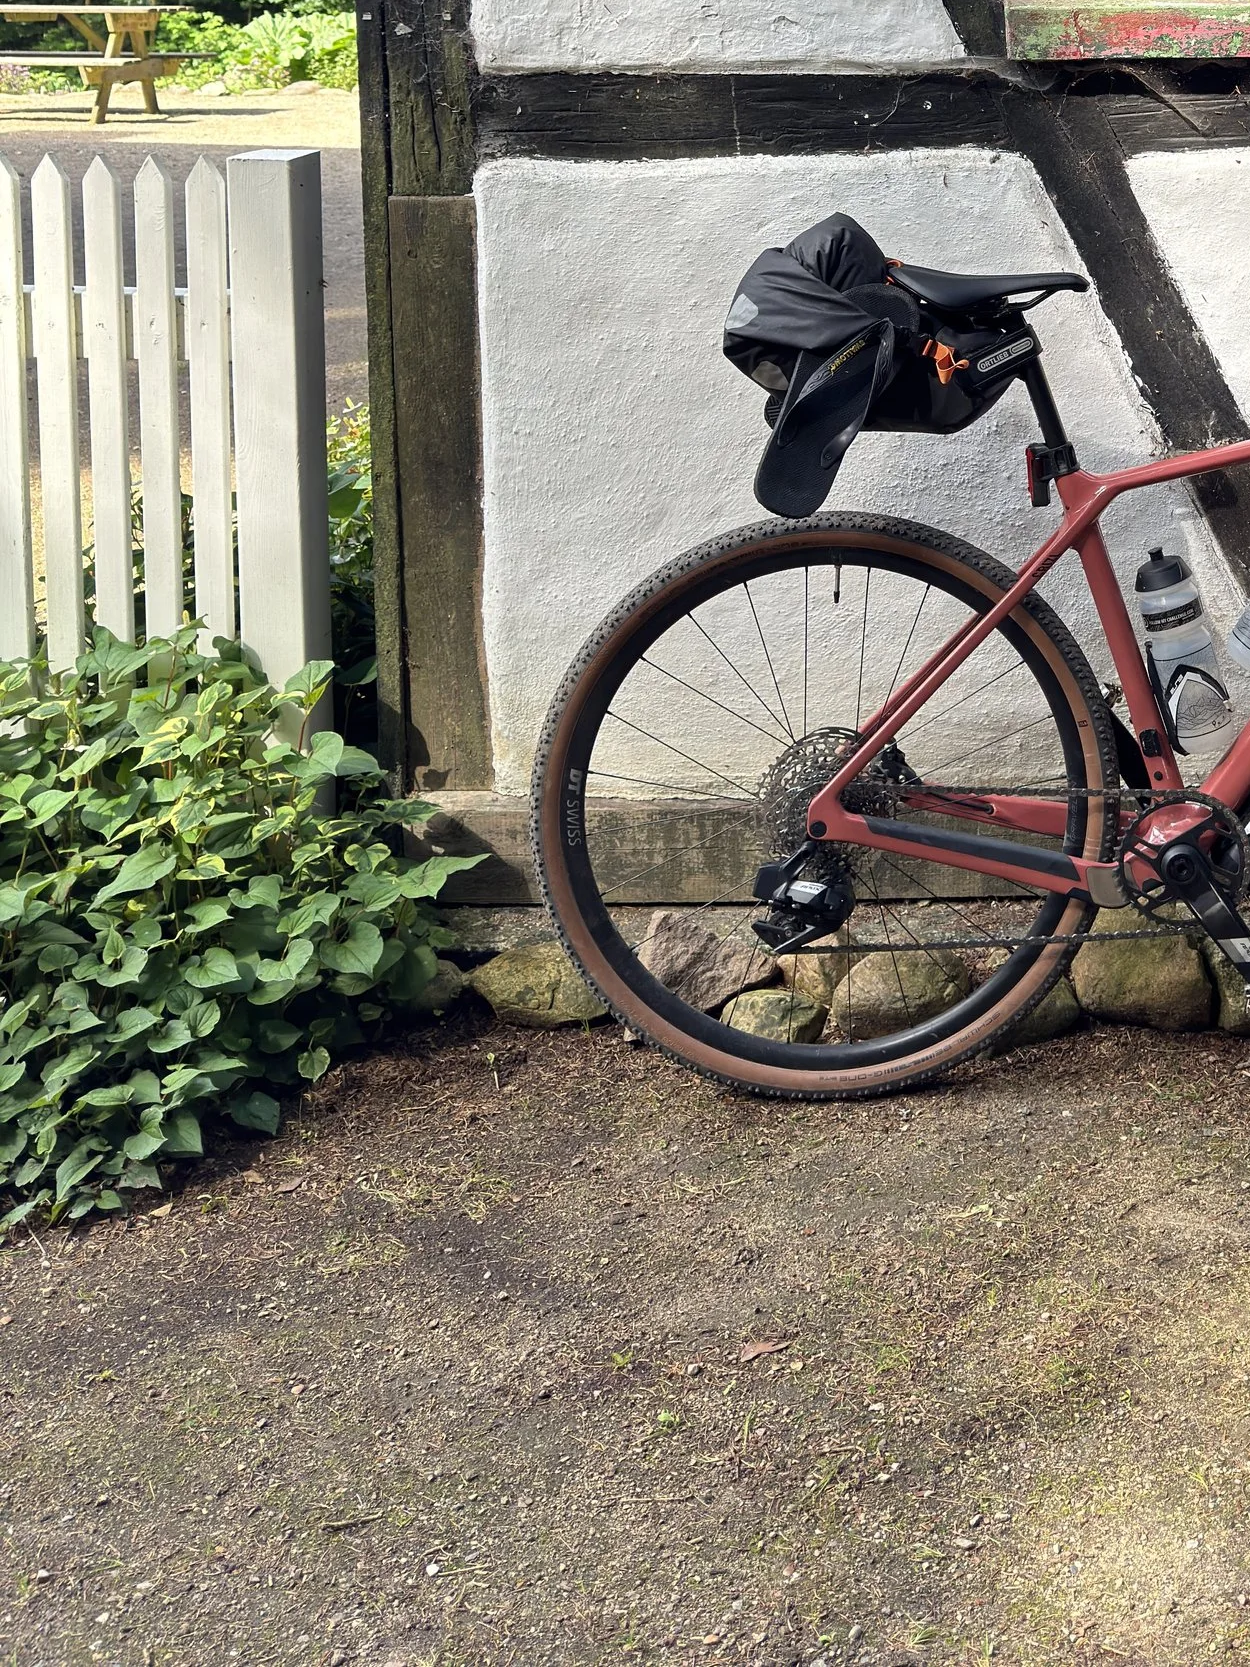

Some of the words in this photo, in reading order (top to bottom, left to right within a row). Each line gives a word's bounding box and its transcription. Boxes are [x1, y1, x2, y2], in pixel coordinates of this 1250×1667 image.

[980, 351, 1009, 370] ORTLIEB
[567, 767, 584, 796] DT
[566, 798, 581, 847] SWISS
